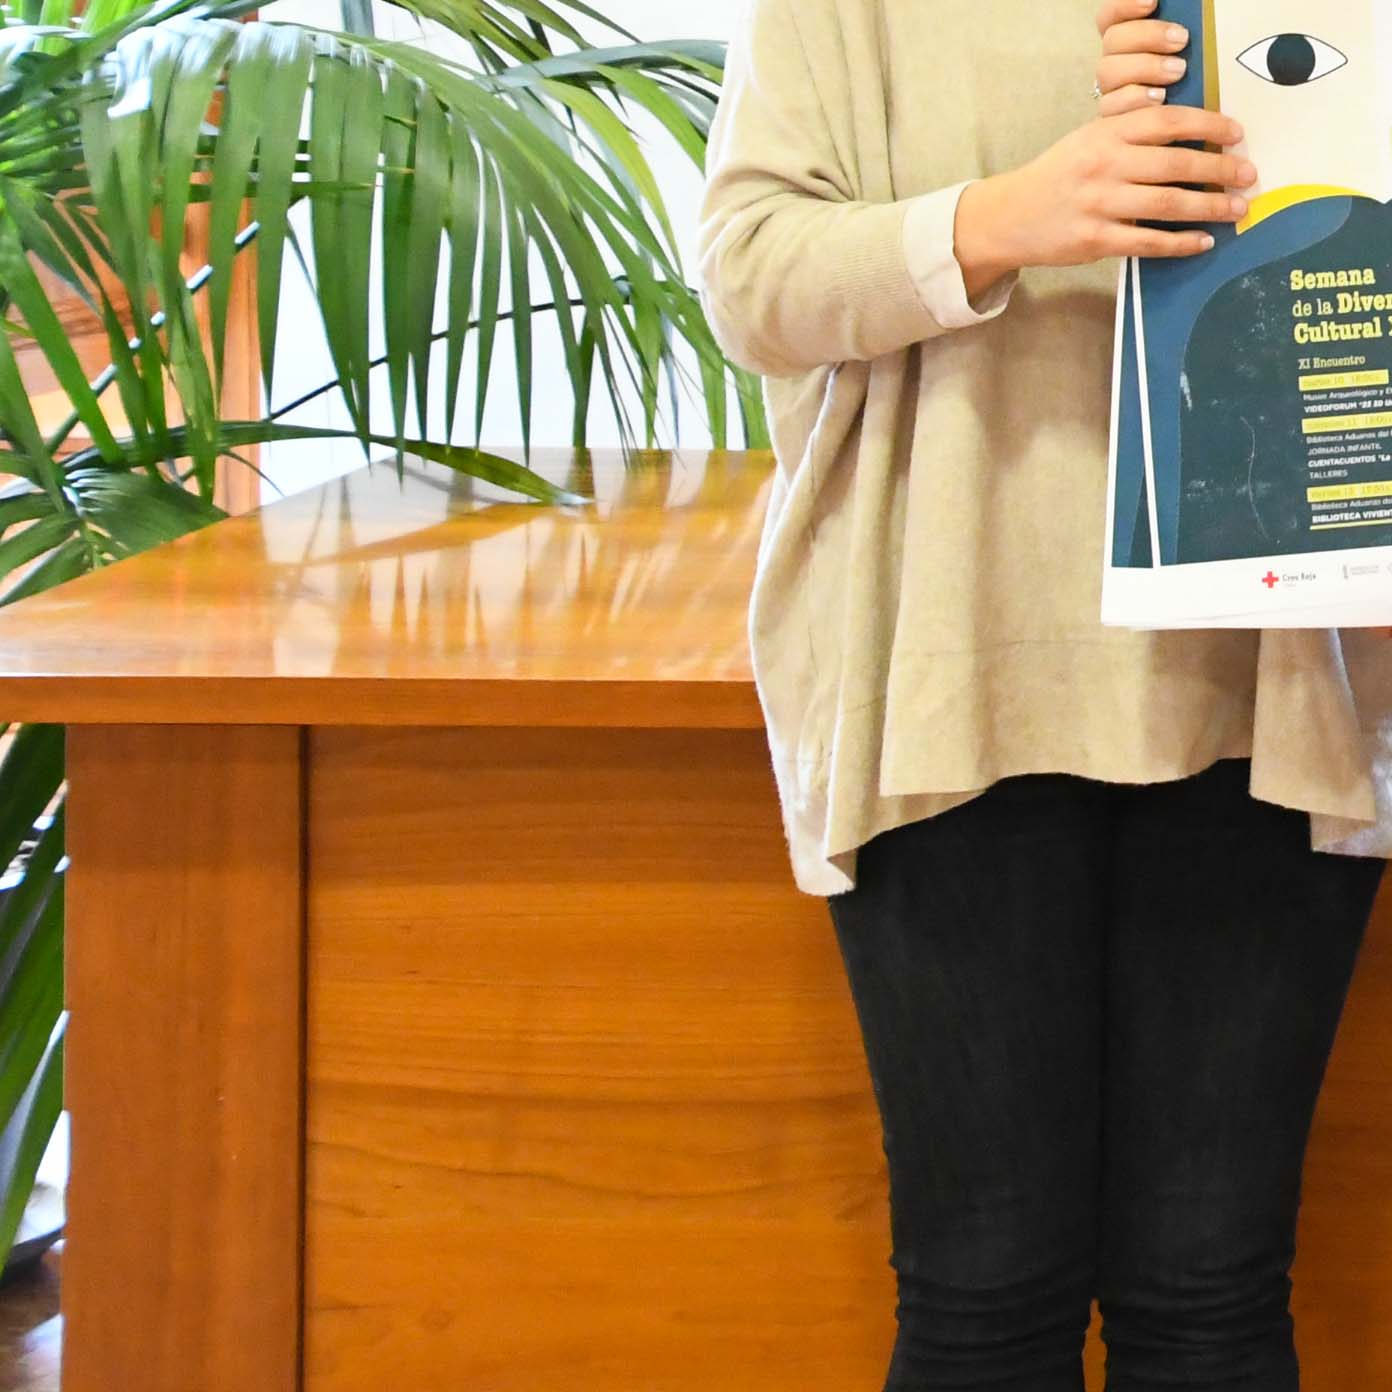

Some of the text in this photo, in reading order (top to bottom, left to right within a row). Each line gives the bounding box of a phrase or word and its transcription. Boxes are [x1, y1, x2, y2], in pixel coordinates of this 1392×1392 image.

[1290, 268, 1375, 290] Semana
[1292, 299, 1312, 317] de
[1317, 298, 1333, 315] la
[1294, 316, 1383, 344] Cultural
[1298, 355, 1366, 369] XI Encuentro
[1308, 446, 1345, 456] JORNADA
[1308, 454, 1376, 468] CUENTACUENTOS
[1309, 469, 1348, 479] TALLERES
[1312, 511, 1361, 524] BIBLIOTECA
